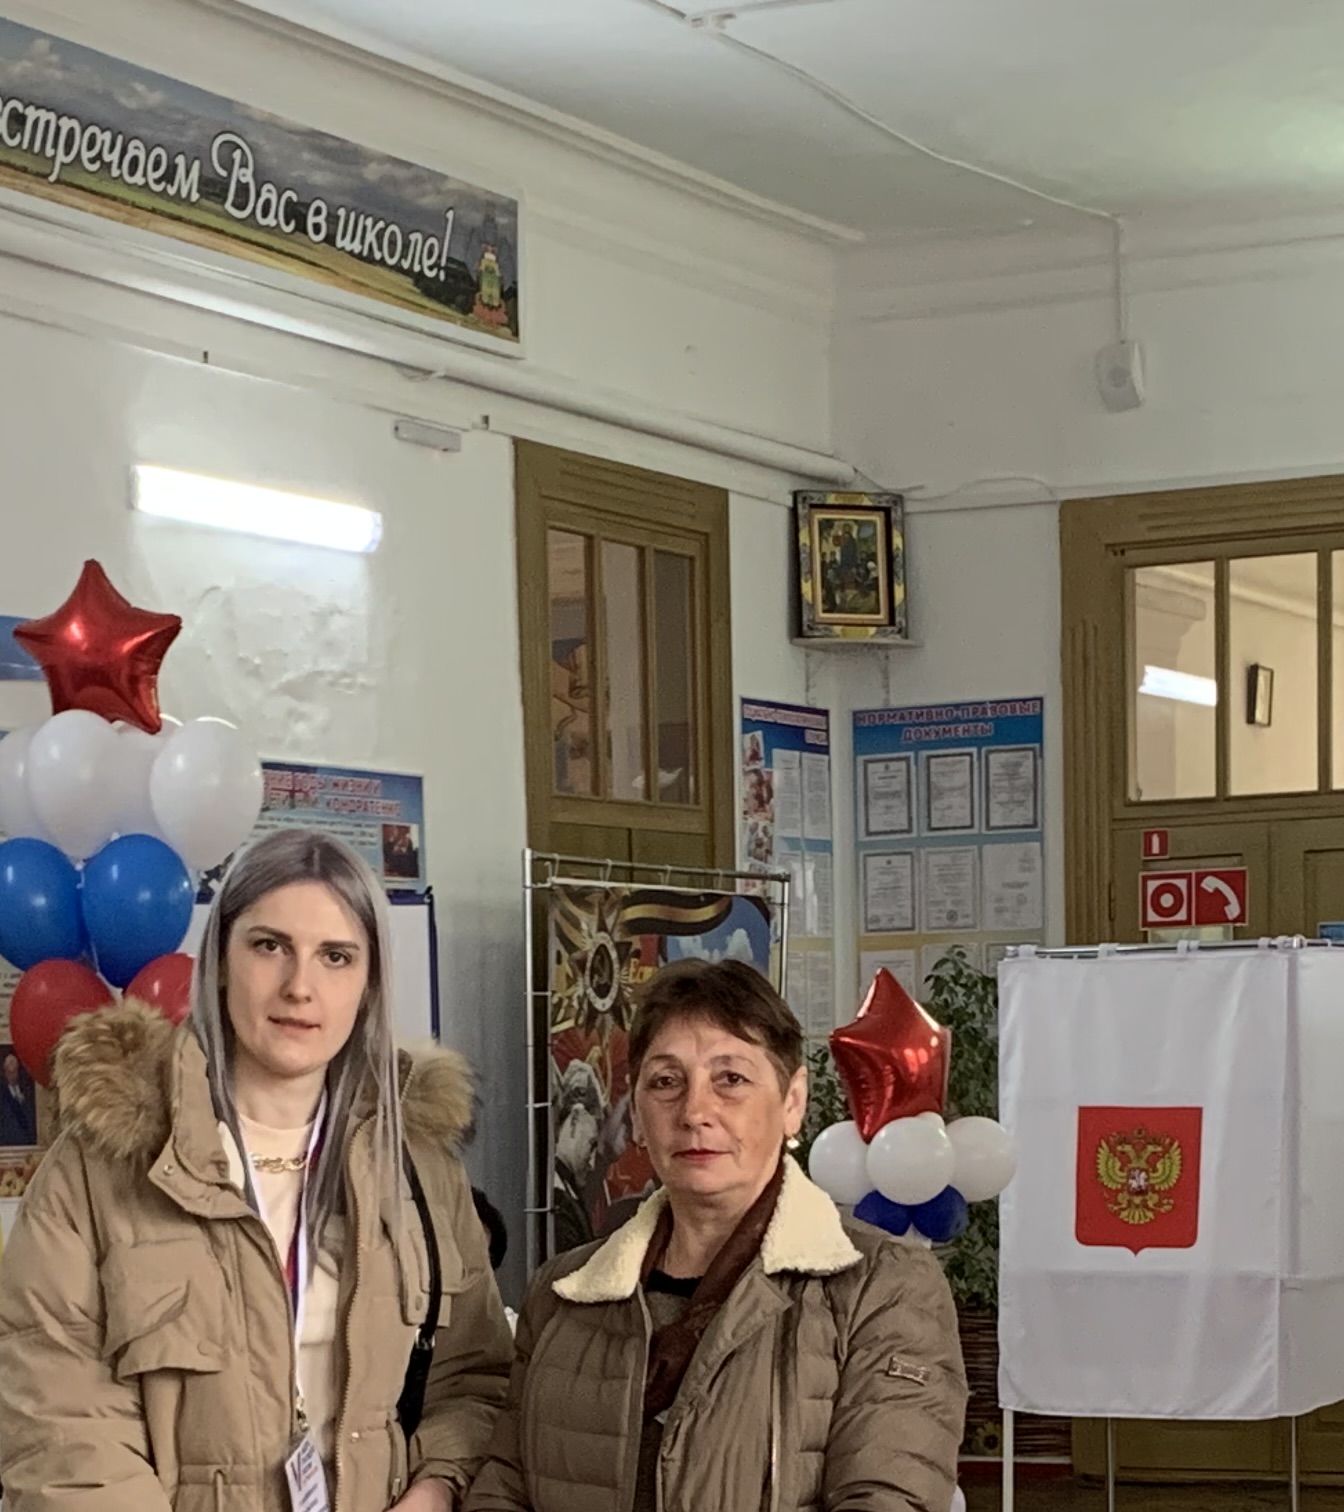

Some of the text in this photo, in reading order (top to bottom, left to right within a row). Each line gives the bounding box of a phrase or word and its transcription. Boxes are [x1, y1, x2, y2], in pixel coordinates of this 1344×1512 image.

[211, 131, 297, 233] Вас
[305, 199, 328, 243] в
[336, 206, 455, 282] школе!
